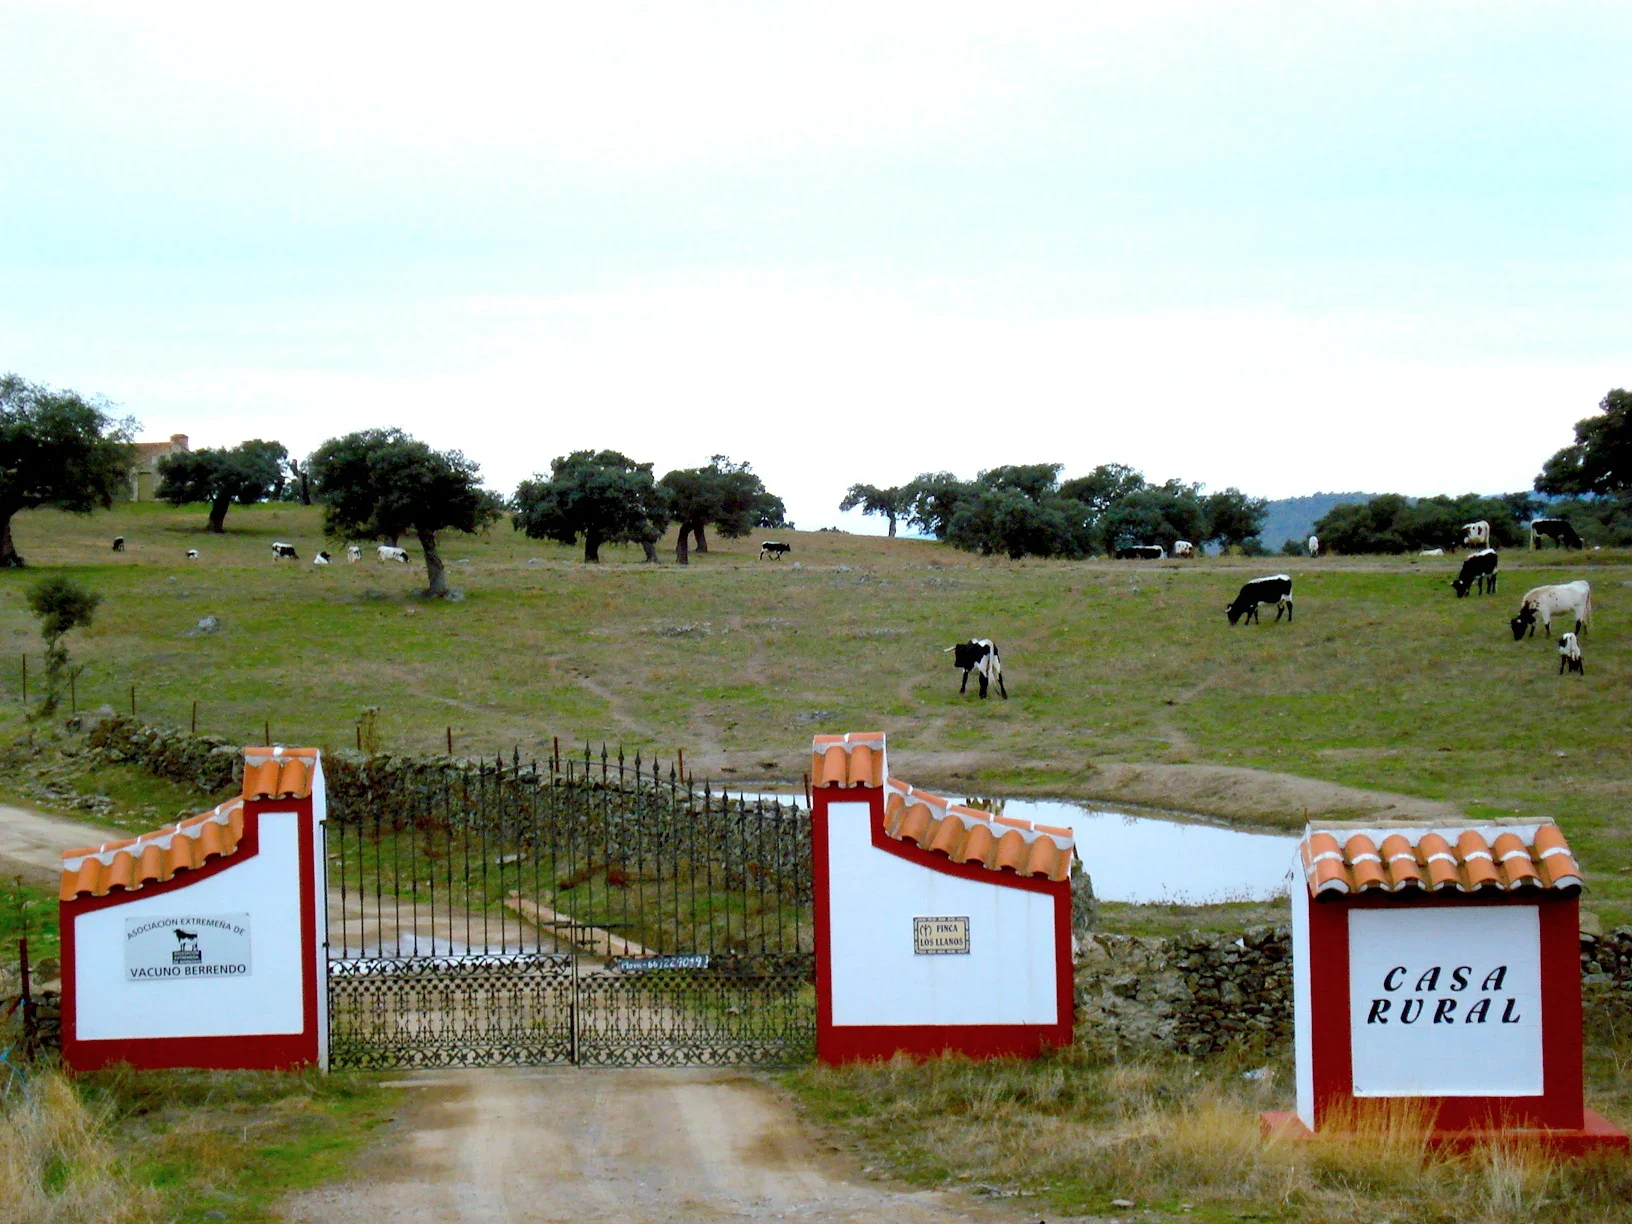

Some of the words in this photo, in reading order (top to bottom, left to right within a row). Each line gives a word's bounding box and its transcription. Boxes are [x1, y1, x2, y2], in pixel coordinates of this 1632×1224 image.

[127, 918, 178, 940] ASOCIACIÓN
[180, 918, 231, 931] EXTREMEÑA
[233, 925, 245, 936] DE
[936, 924, 958, 933] FINCA
[920, 938, 934, 947] LOS
[935, 938, 964, 946] LLANOS
[130, 966, 181, 978] VACUNO
[184, 964, 247, 976] BERRENDO
[1383, 965, 1508, 992] CASA
[1367, 998, 1521, 1024] RURAL
